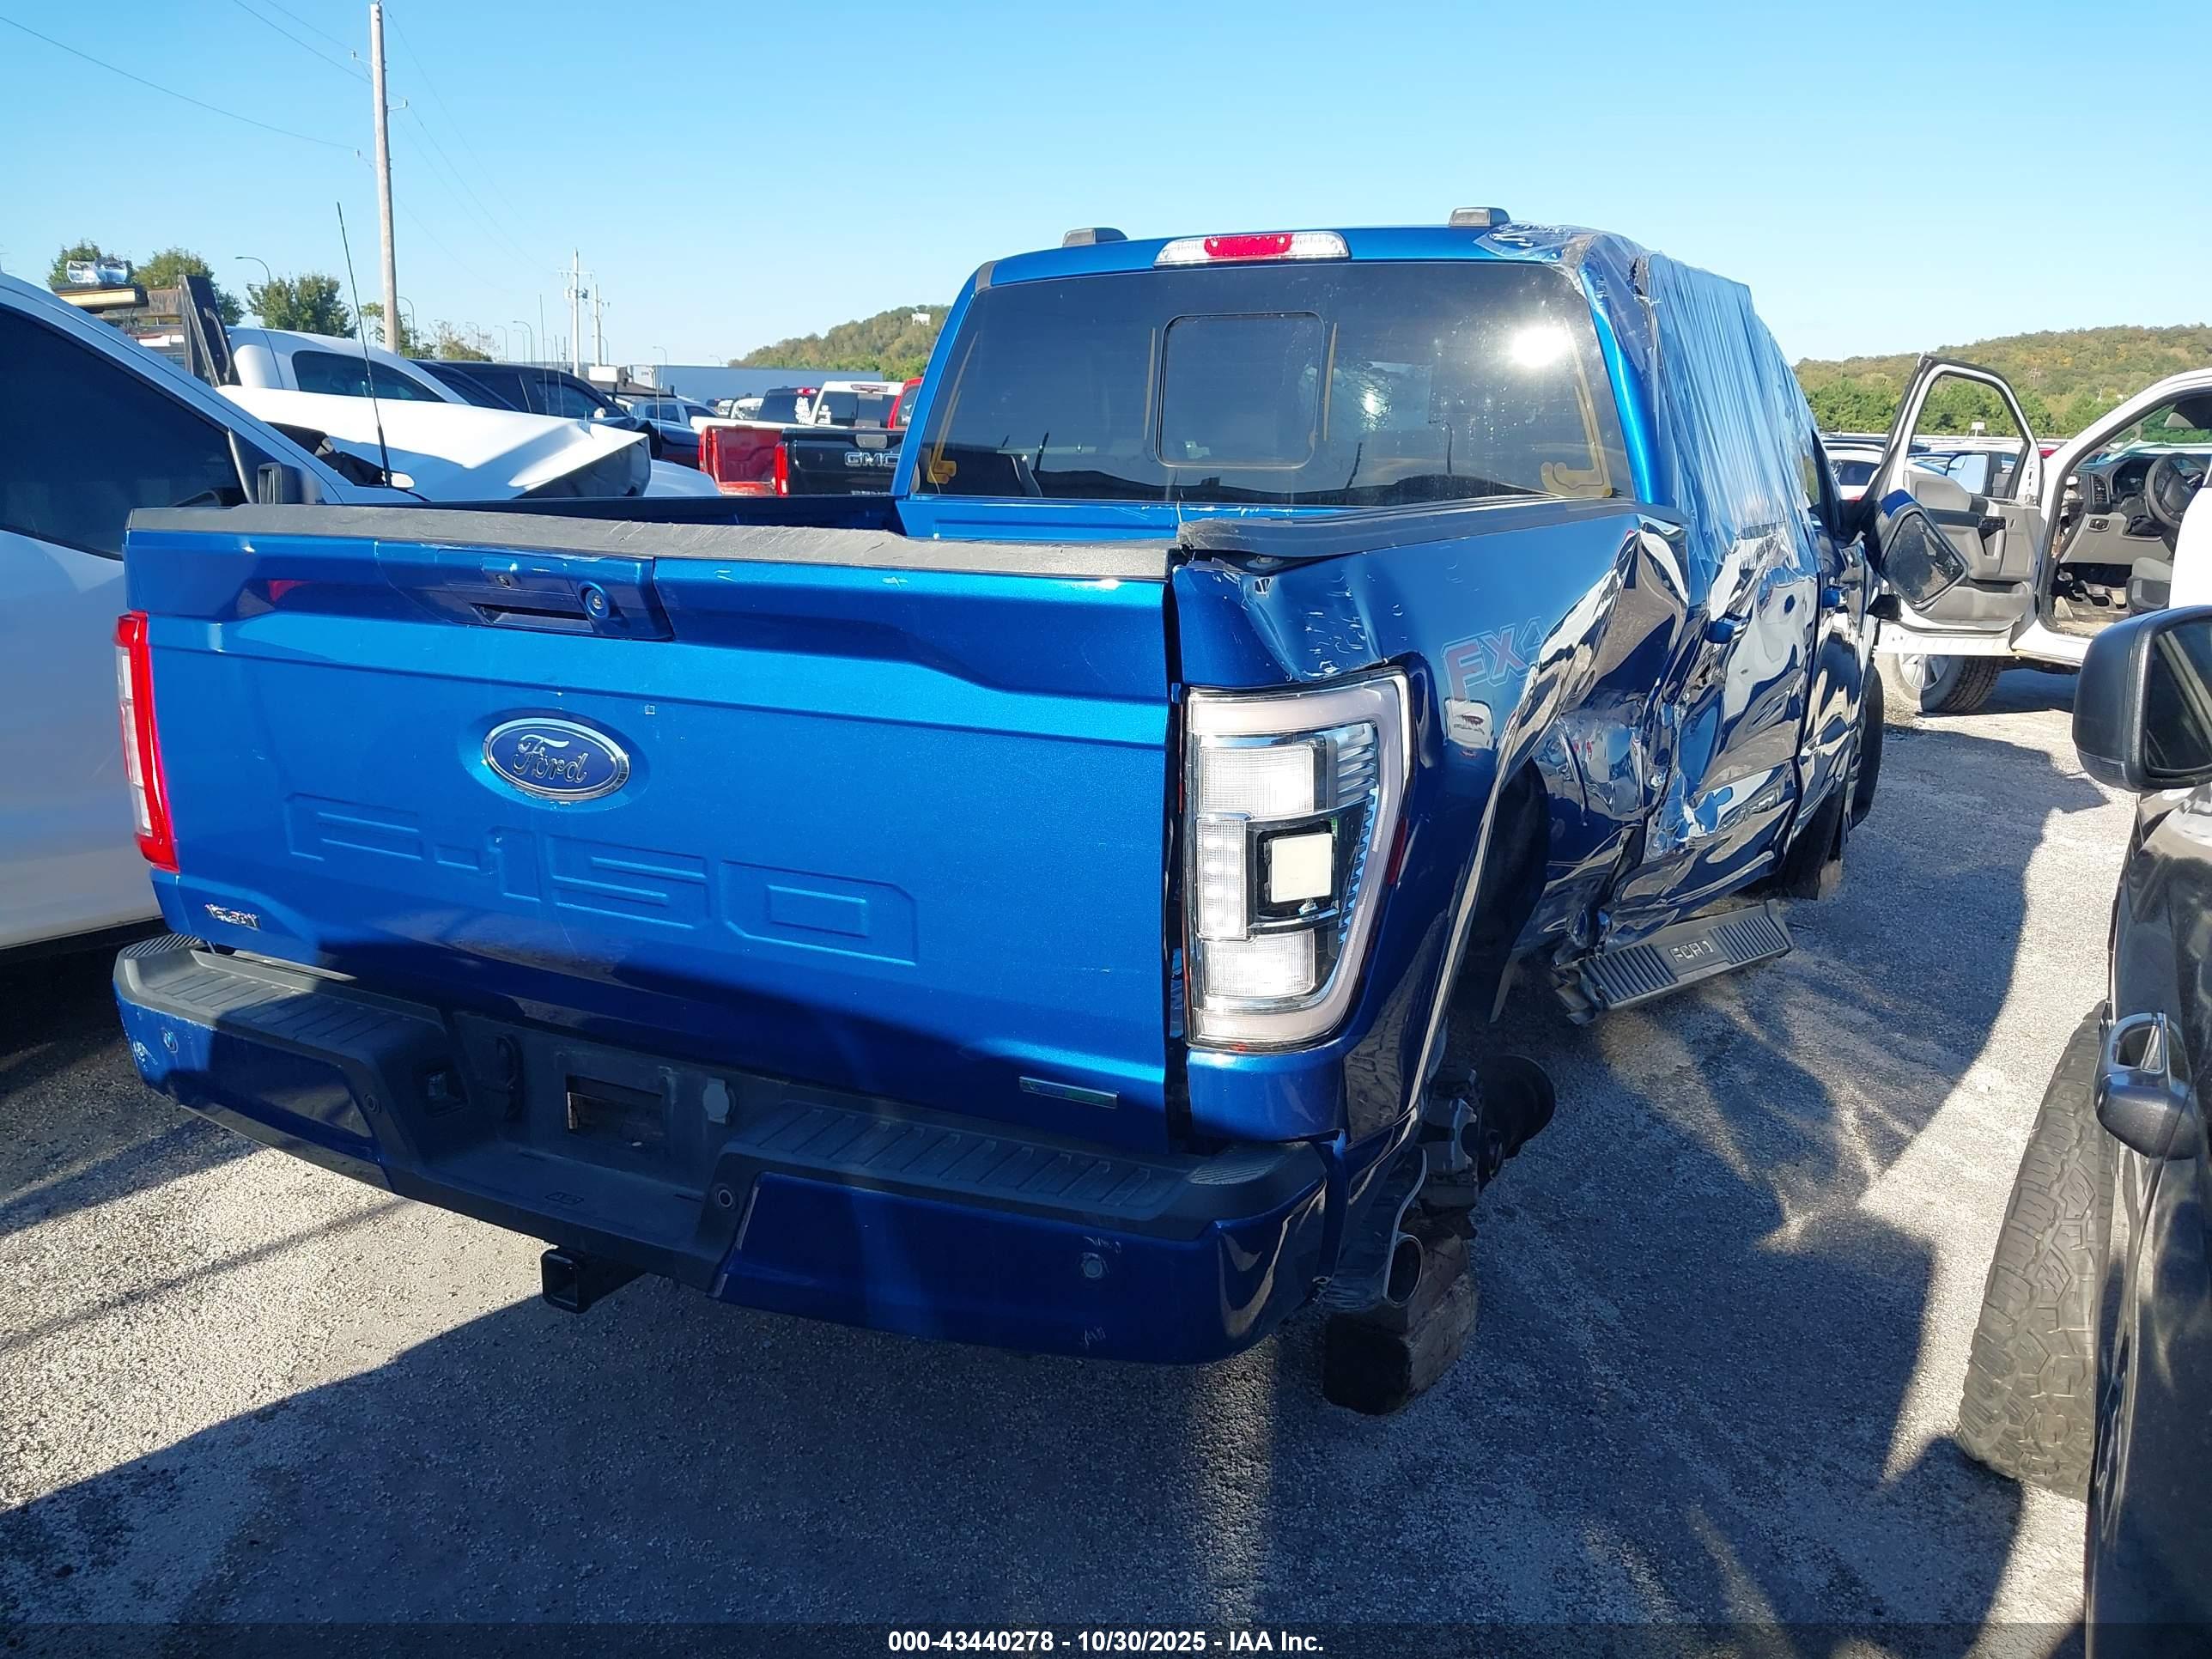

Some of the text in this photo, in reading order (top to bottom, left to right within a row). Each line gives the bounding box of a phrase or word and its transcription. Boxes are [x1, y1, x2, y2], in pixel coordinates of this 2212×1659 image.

[844, 452, 901, 467] GMC
[511, 733, 590, 785] Ford
[284, 792, 918, 967] F-150
